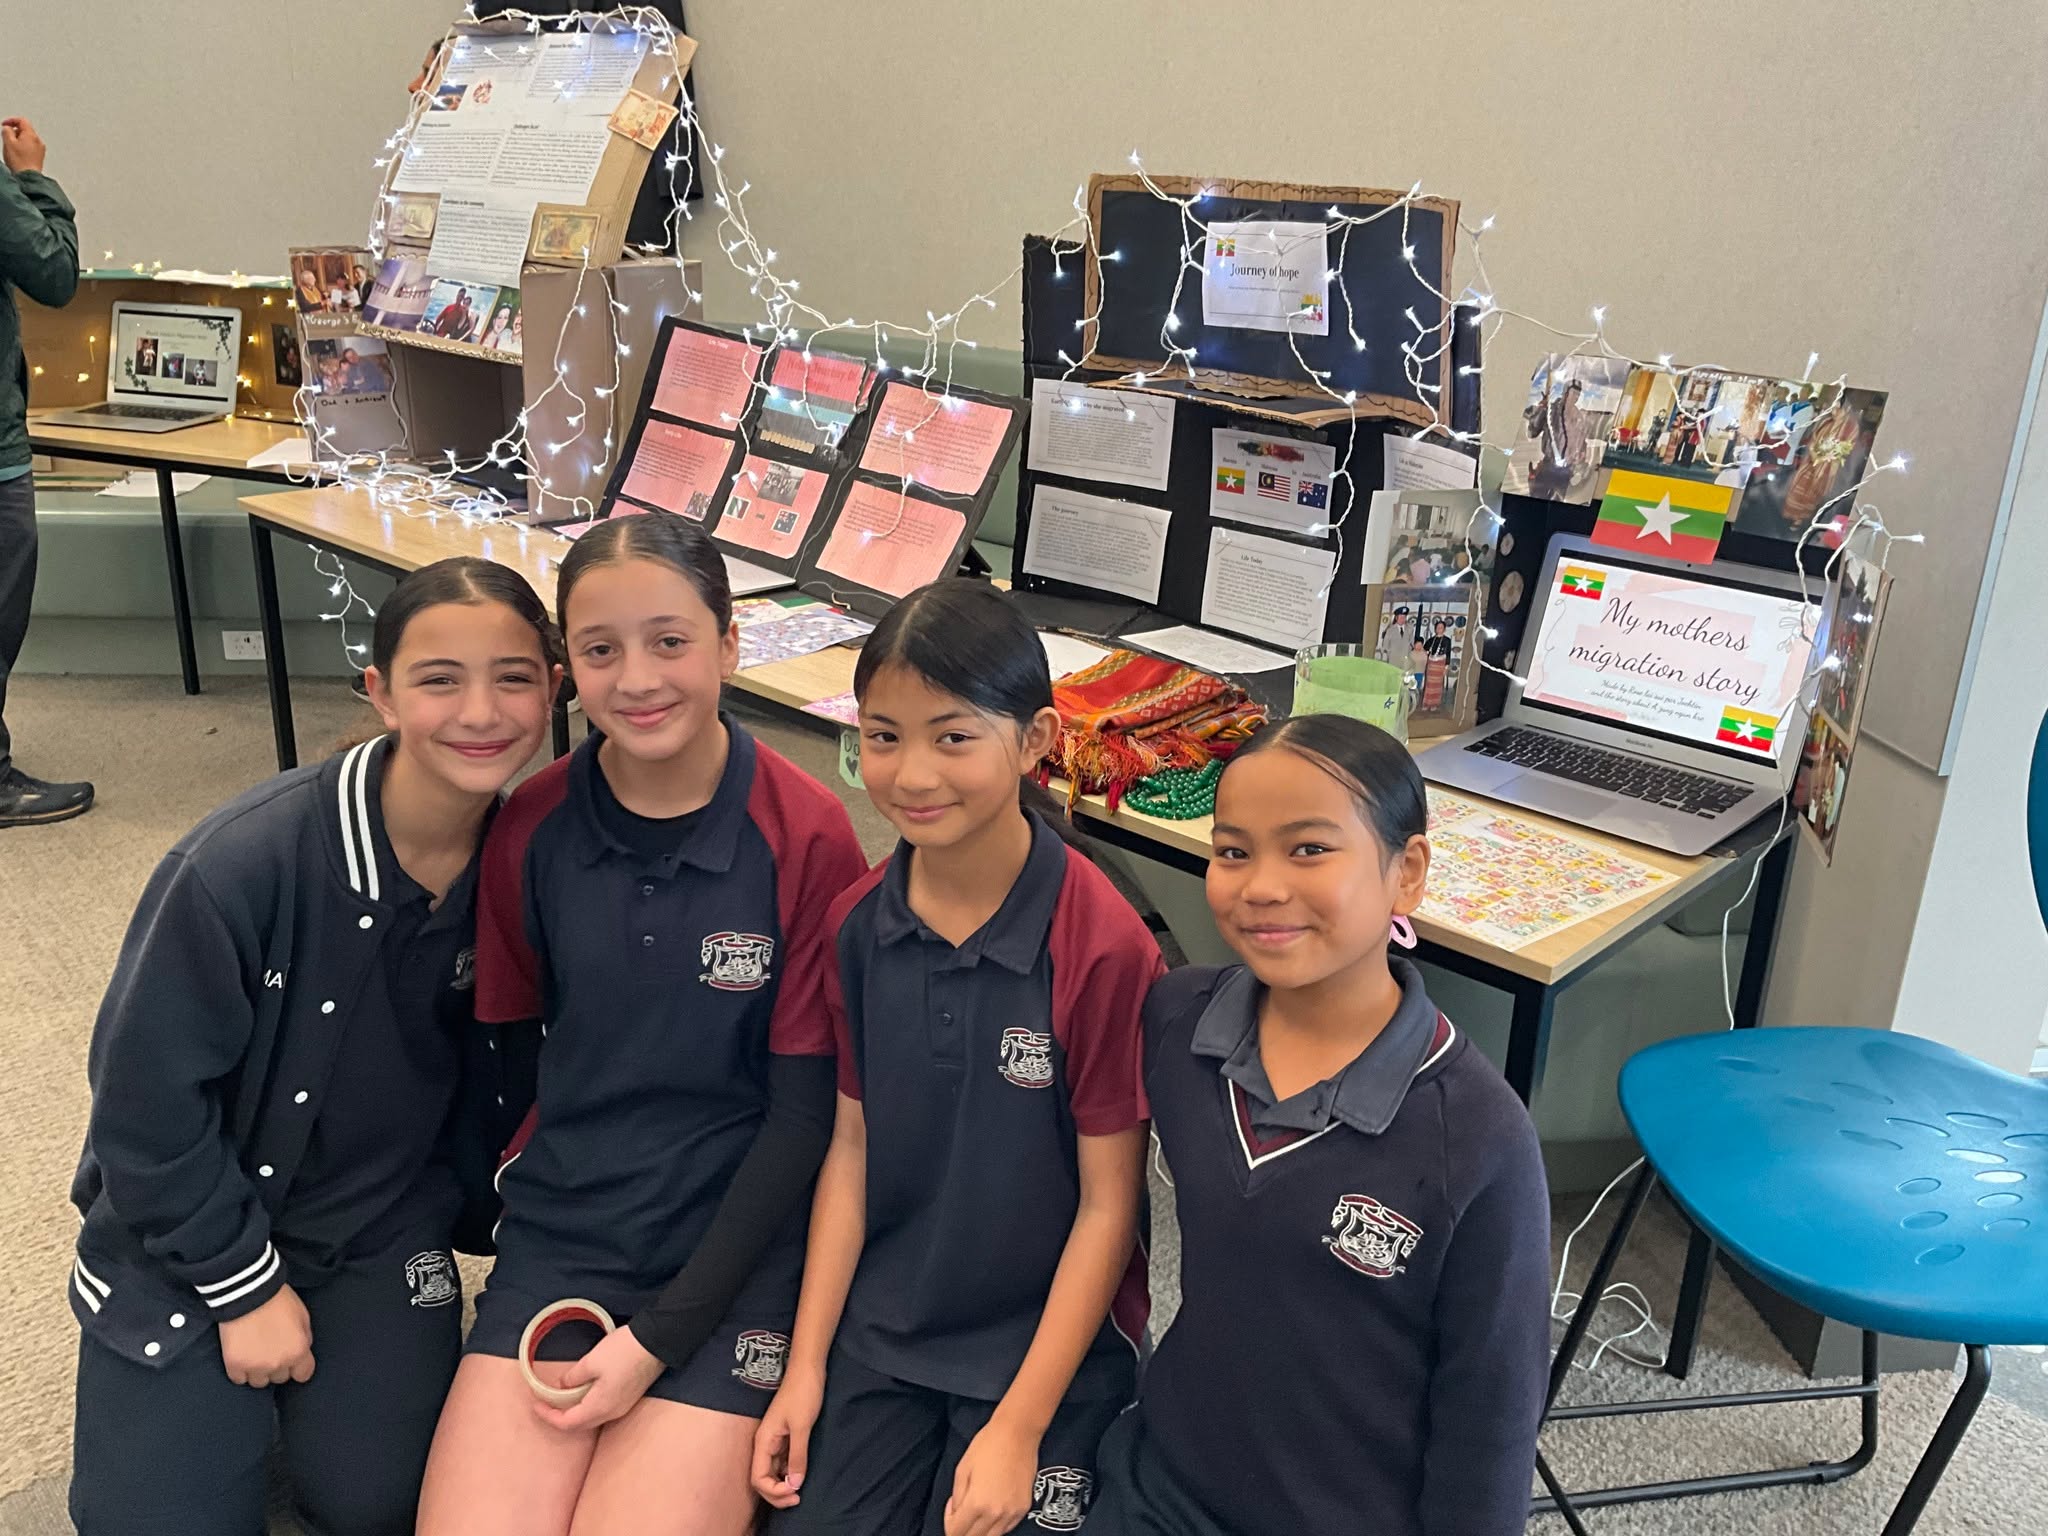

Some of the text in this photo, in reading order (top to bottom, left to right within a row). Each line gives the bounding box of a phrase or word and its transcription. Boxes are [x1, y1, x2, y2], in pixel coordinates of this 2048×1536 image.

[1230, 264, 1266, 279] Journey
[1280, 266, 1299, 280] hope
[1250, 556, 1263, 565] Today
[1600, 597, 1750, 652] My mothers
[1568, 644, 1761, 706] migration story
